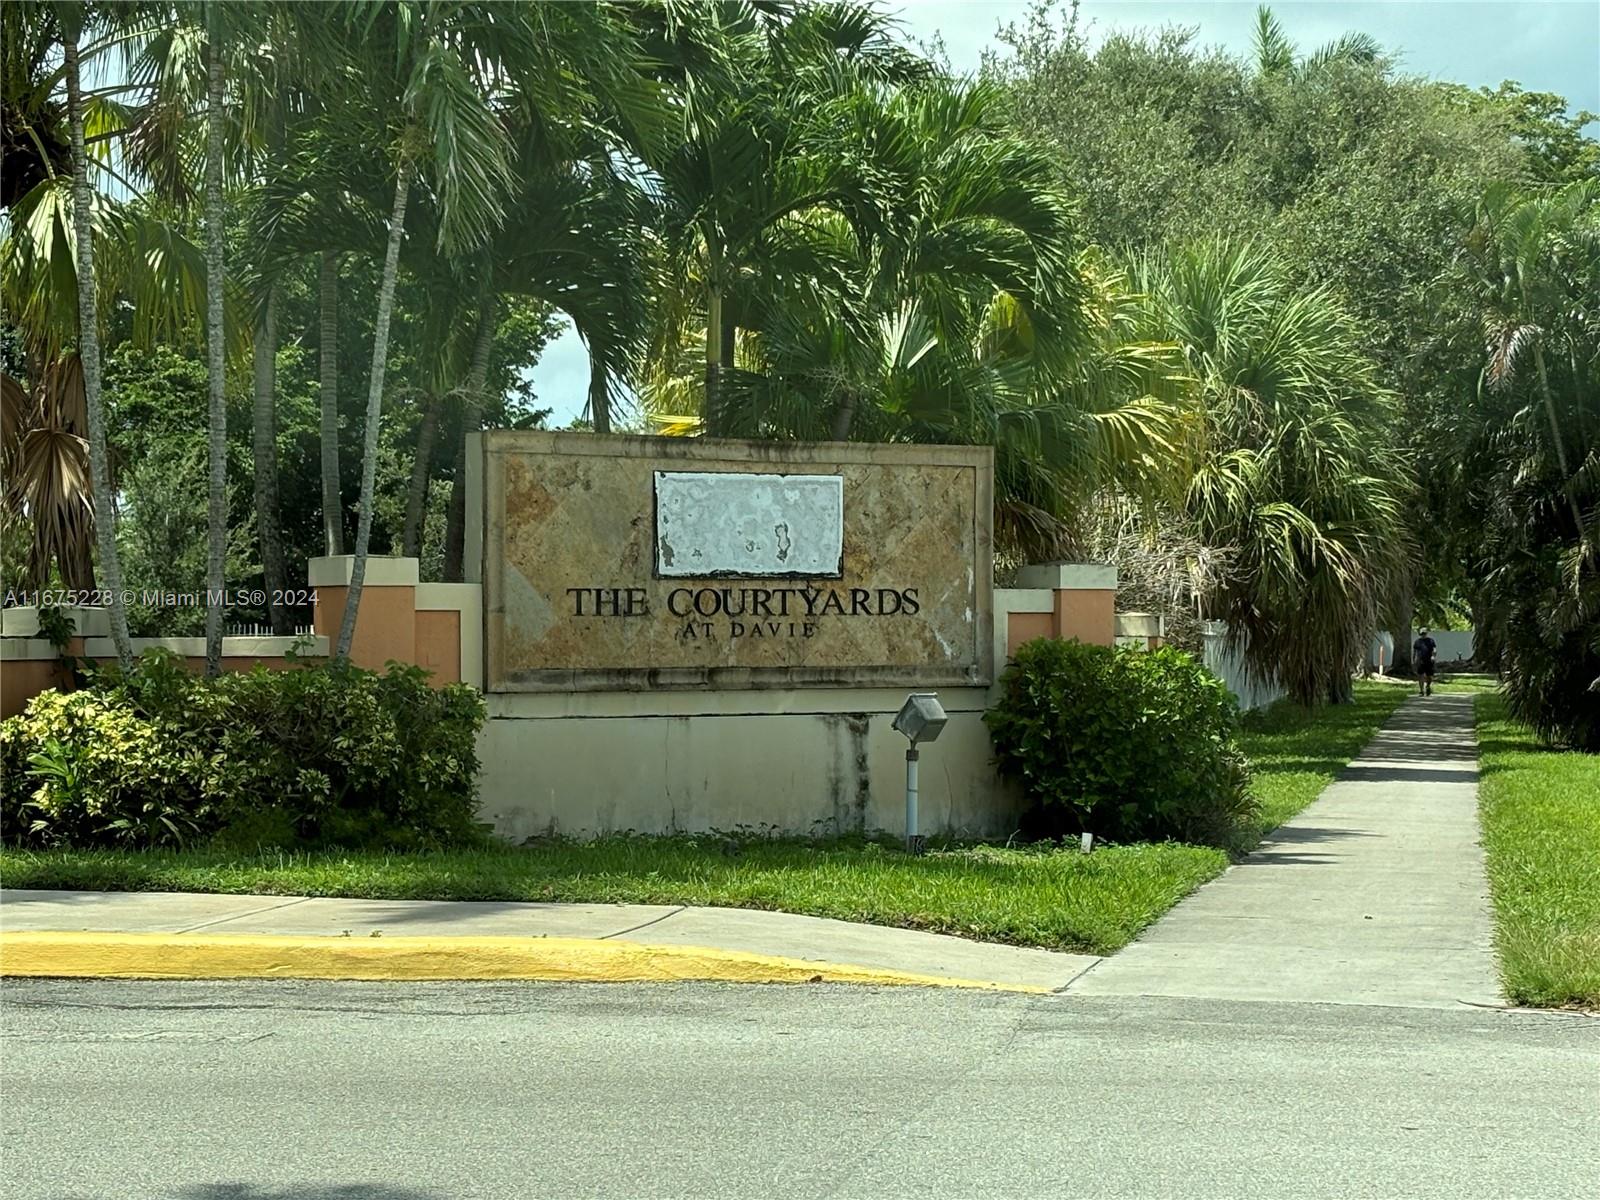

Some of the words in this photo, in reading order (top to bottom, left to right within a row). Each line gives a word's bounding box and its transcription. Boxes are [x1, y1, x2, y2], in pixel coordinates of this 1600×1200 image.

[567, 588, 648, 617] THE
[667, 588, 920, 617] COURTYARDS
[683, 622, 714, 638] AT
[731, 622, 816, 638] DAVIE
